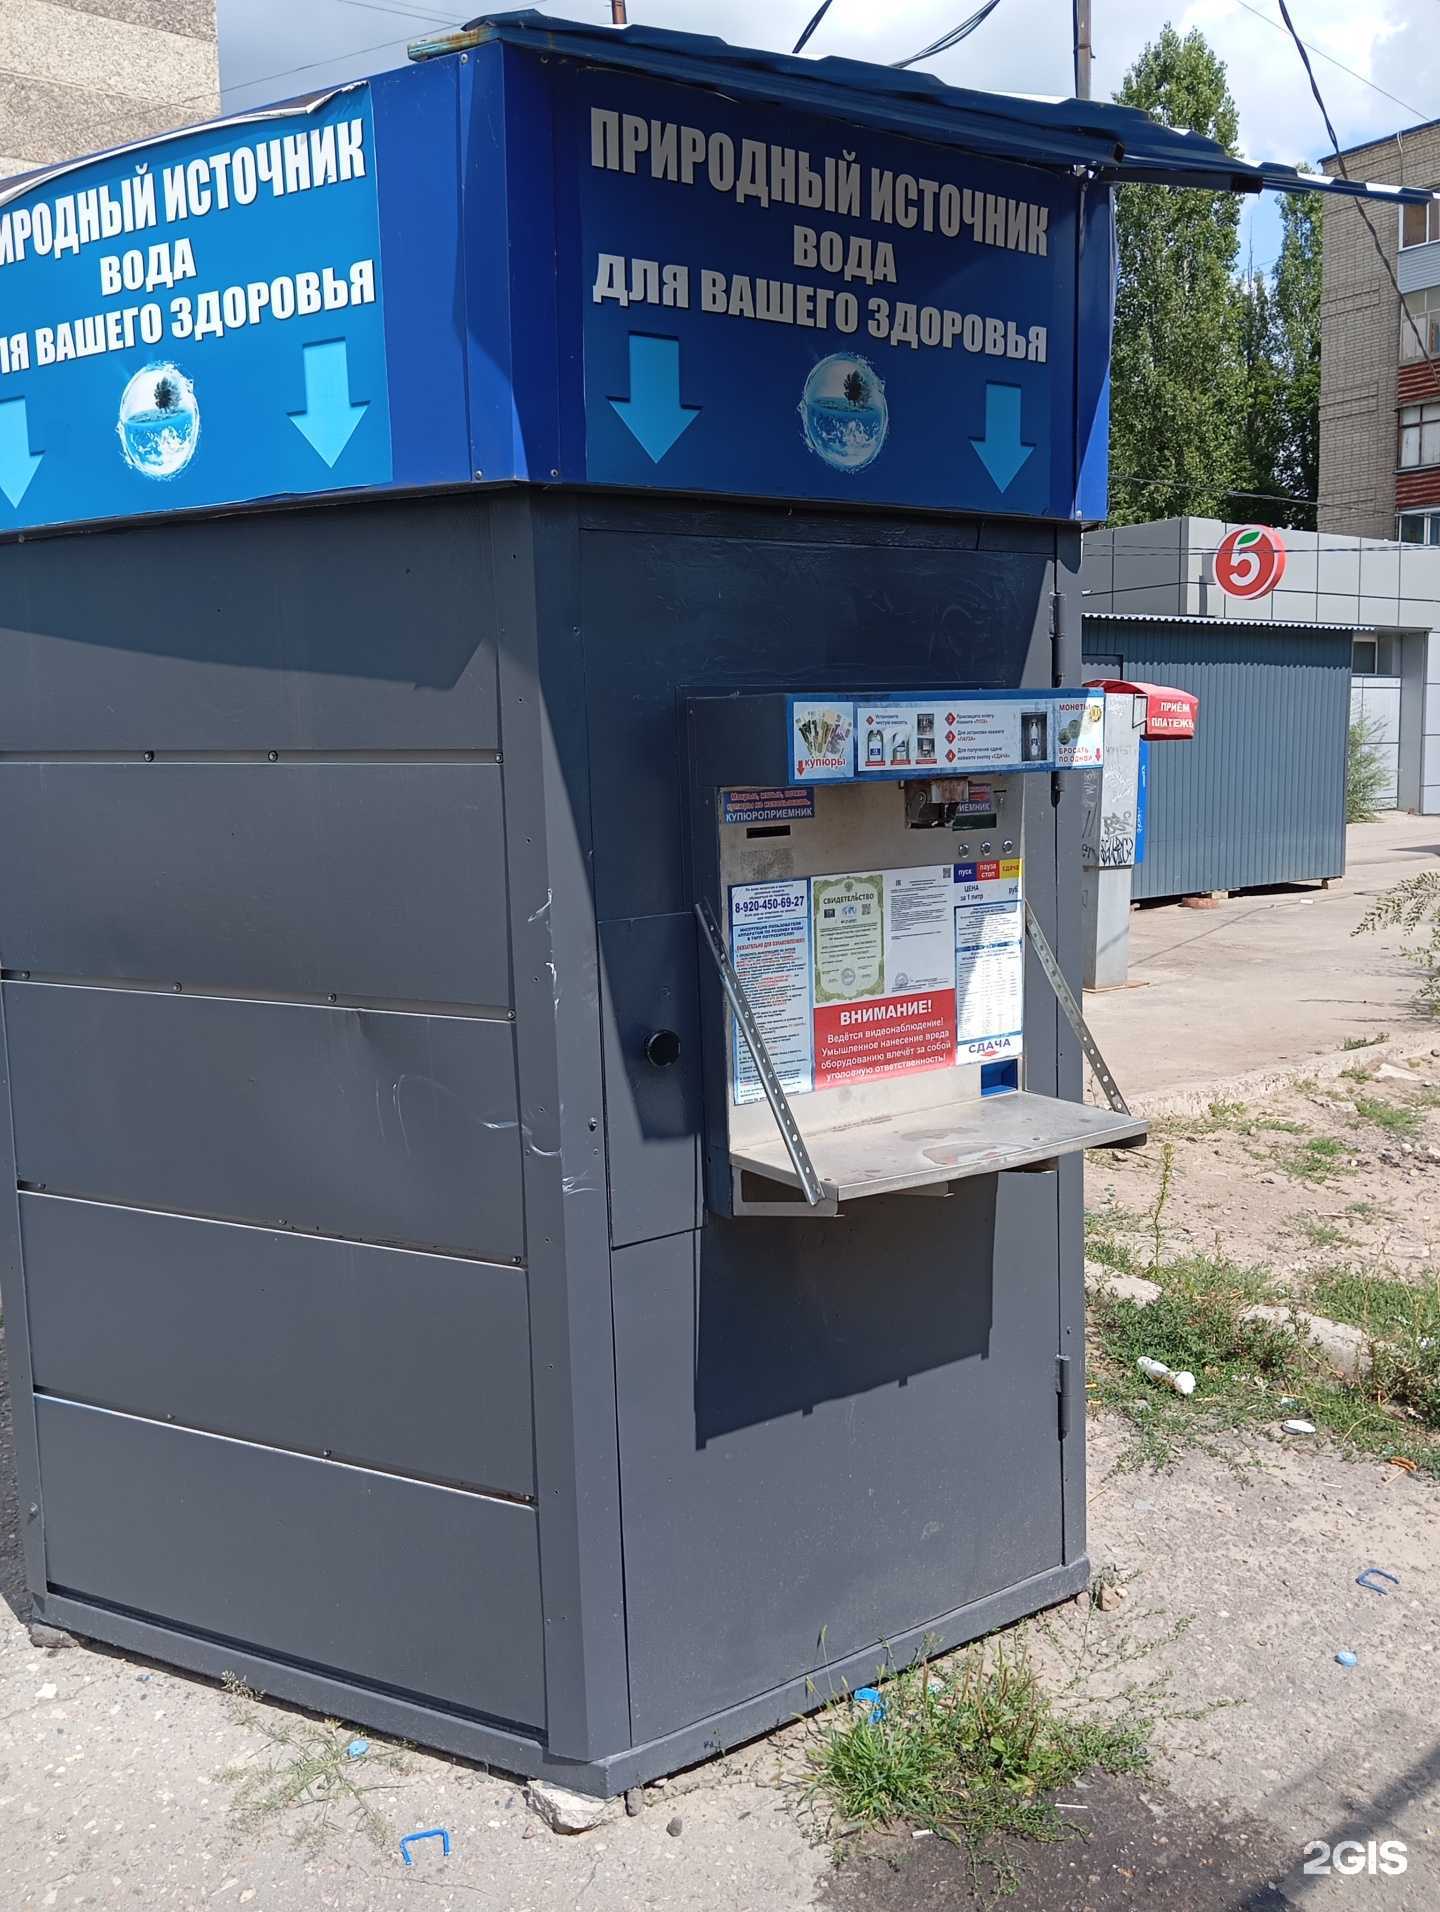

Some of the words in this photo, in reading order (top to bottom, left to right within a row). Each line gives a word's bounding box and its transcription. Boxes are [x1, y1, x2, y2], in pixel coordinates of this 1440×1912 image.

[163, 118, 367, 222] ИСТОЧНИК
[591, 107, 860, 218] ПРИРОДНЫЙ
[870, 167, 1049, 256] ИСТОЧНИК
[100, 238, 197, 296] ВОДА
[794, 225, 897, 284] ВОДА
[36, 304, 163, 367] ВАШЕГО
[171, 259, 376, 342] ЗДОРОВЬЯ
[593, 253, 690, 308] ДЛЯ
[701, 269, 858, 334] ВАШЕГО
[868, 297, 1047, 363] ЗДОРОВЬЯ
[1229, 536, 1262, 587] 5
[1160, 701, 1190, 713] ПРИЁМ
[726, 808, 812, 822] КУПЮРОПРИЕМНИК
[735, 896, 805, 913] 8-920-450-69-27
[823, 892, 874, 905] СВИДЕТЕЛЬСТВО
[840, 1000, 932, 1026] ВНИМАНИЕ!
[821, 1042, 879, 1057] Умышленное
[880, 1035, 924, 1048] нанесение
[925, 1030, 950, 1041] вреда
[827, 1032, 863, 1043] Ведётся
[865, 1017, 944, 1038] видеонаблюдение!
[821, 1054, 884, 1069] оборудованию
[886, 1047, 914, 1058] влечёт
[927, 1040, 951, 1052] собой
[969, 1038, 1011, 1053] СДАЧА
[826, 1067, 873, 1081] уголовную
[875, 1054, 946, 1072] ответственность!
